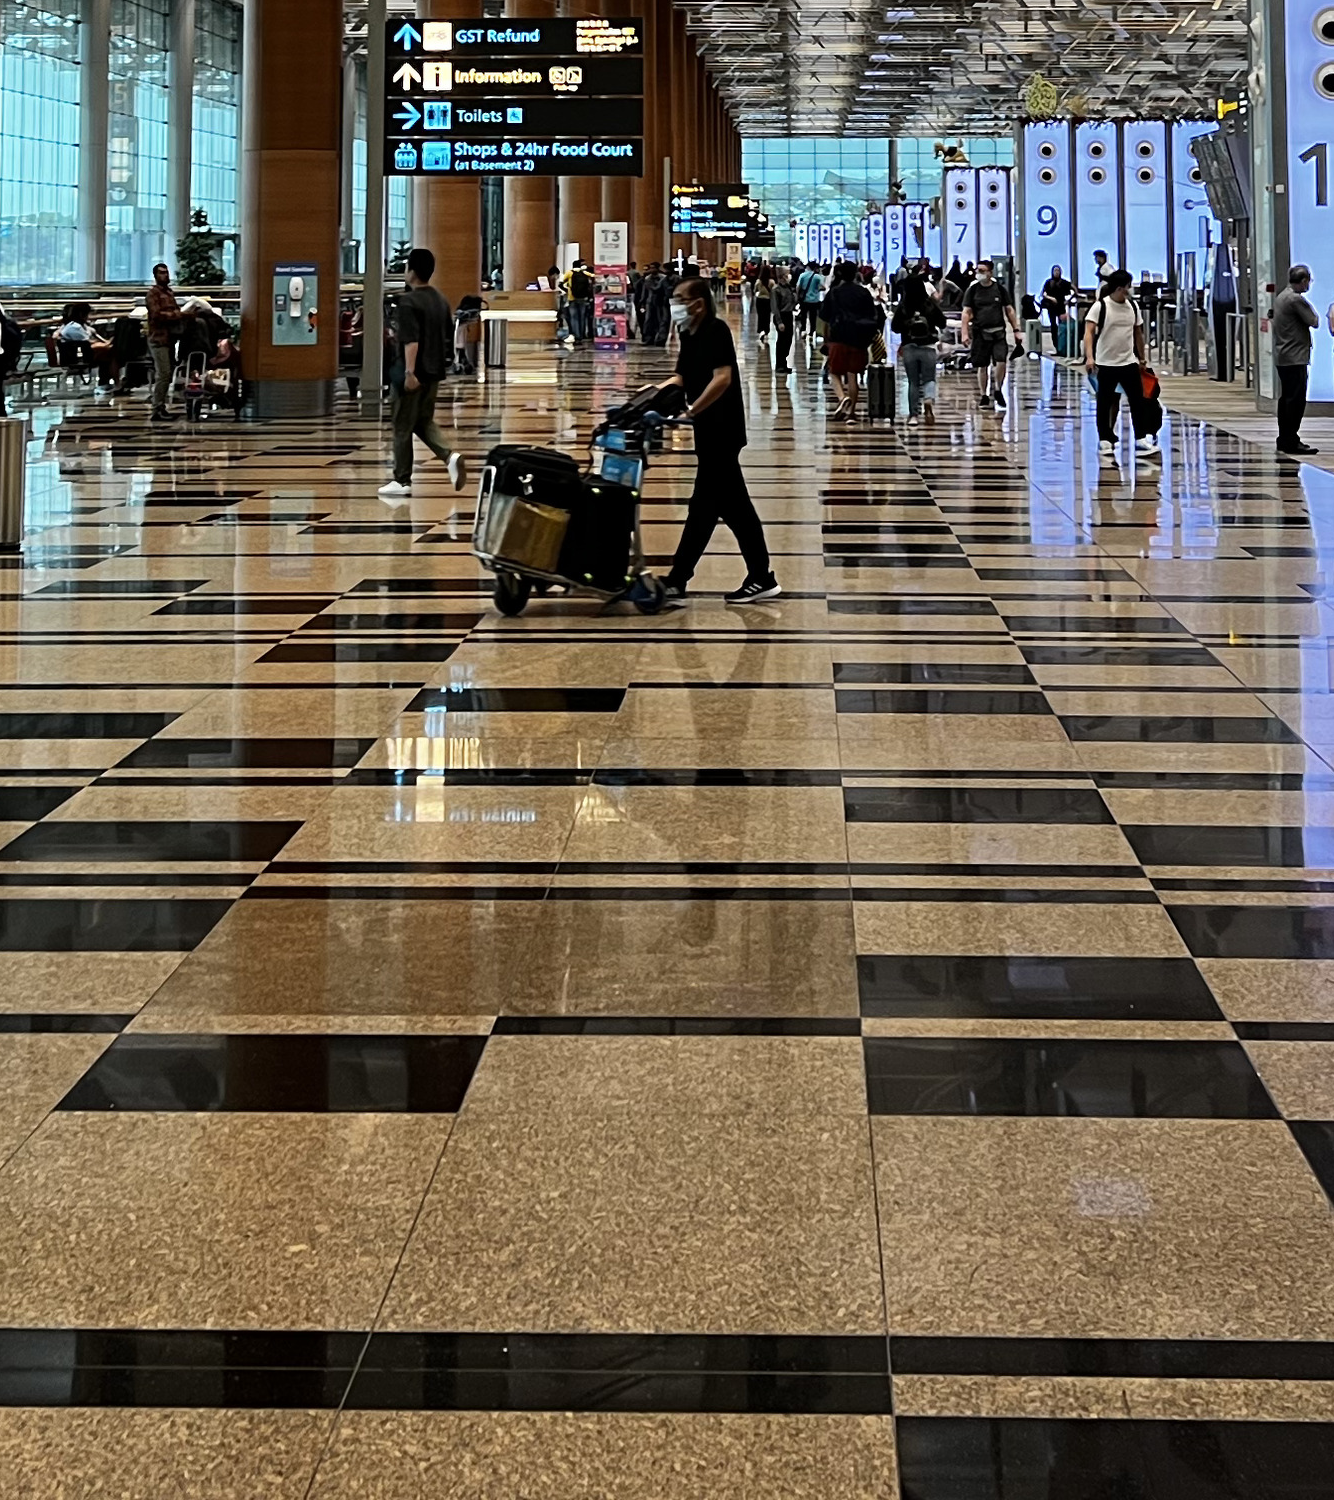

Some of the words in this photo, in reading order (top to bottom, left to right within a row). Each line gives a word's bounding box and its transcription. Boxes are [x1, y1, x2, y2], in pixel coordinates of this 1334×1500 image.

[455, 29, 485, 44] GST
[487, 28, 541, 43] Refund
[455, 68, 543, 84] Information
[456, 109, 503, 123] Toilets
[454, 142, 498, 159] Shops
[501, 142, 513, 156] &
[515, 142, 550, 156] 24hr
[552, 142, 589, 156] Food
[592, 142, 633, 156] Court
[471, 160, 522, 171] Basement
[523, 160, 535, 171] 2)
[1036, 204, 1059, 237] 9
[601, 229, 620, 242] T3
[954, 222, 968, 243] 7
[891, 237, 899, 250] 5
